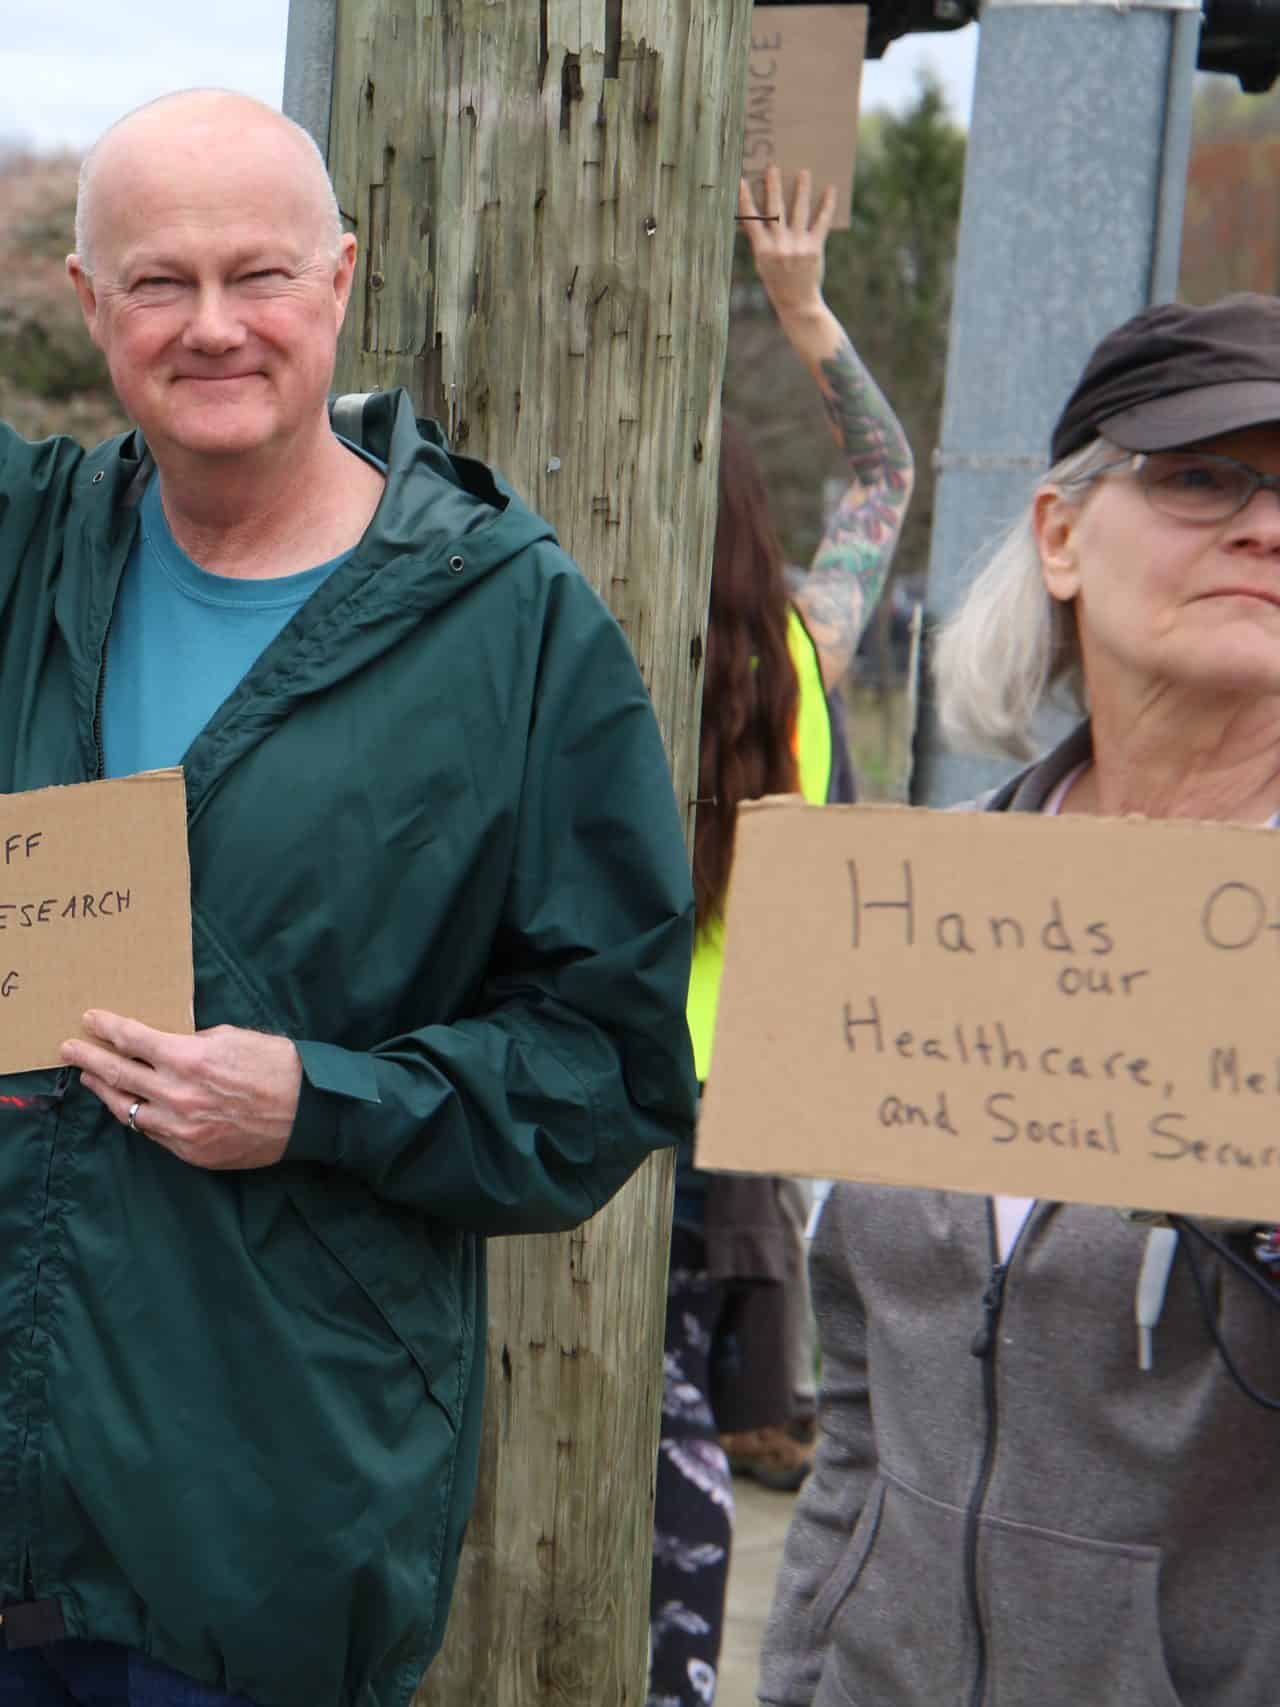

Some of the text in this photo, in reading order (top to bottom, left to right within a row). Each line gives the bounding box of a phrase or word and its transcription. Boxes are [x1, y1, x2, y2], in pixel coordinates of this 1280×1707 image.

[847, 859, 1280, 955] Hands O
[1057, 966, 1150, 997] our
[843, 996, 1280, 1098] Healthcare, Me
[879, 1092, 1280, 1170] and Social Secur
